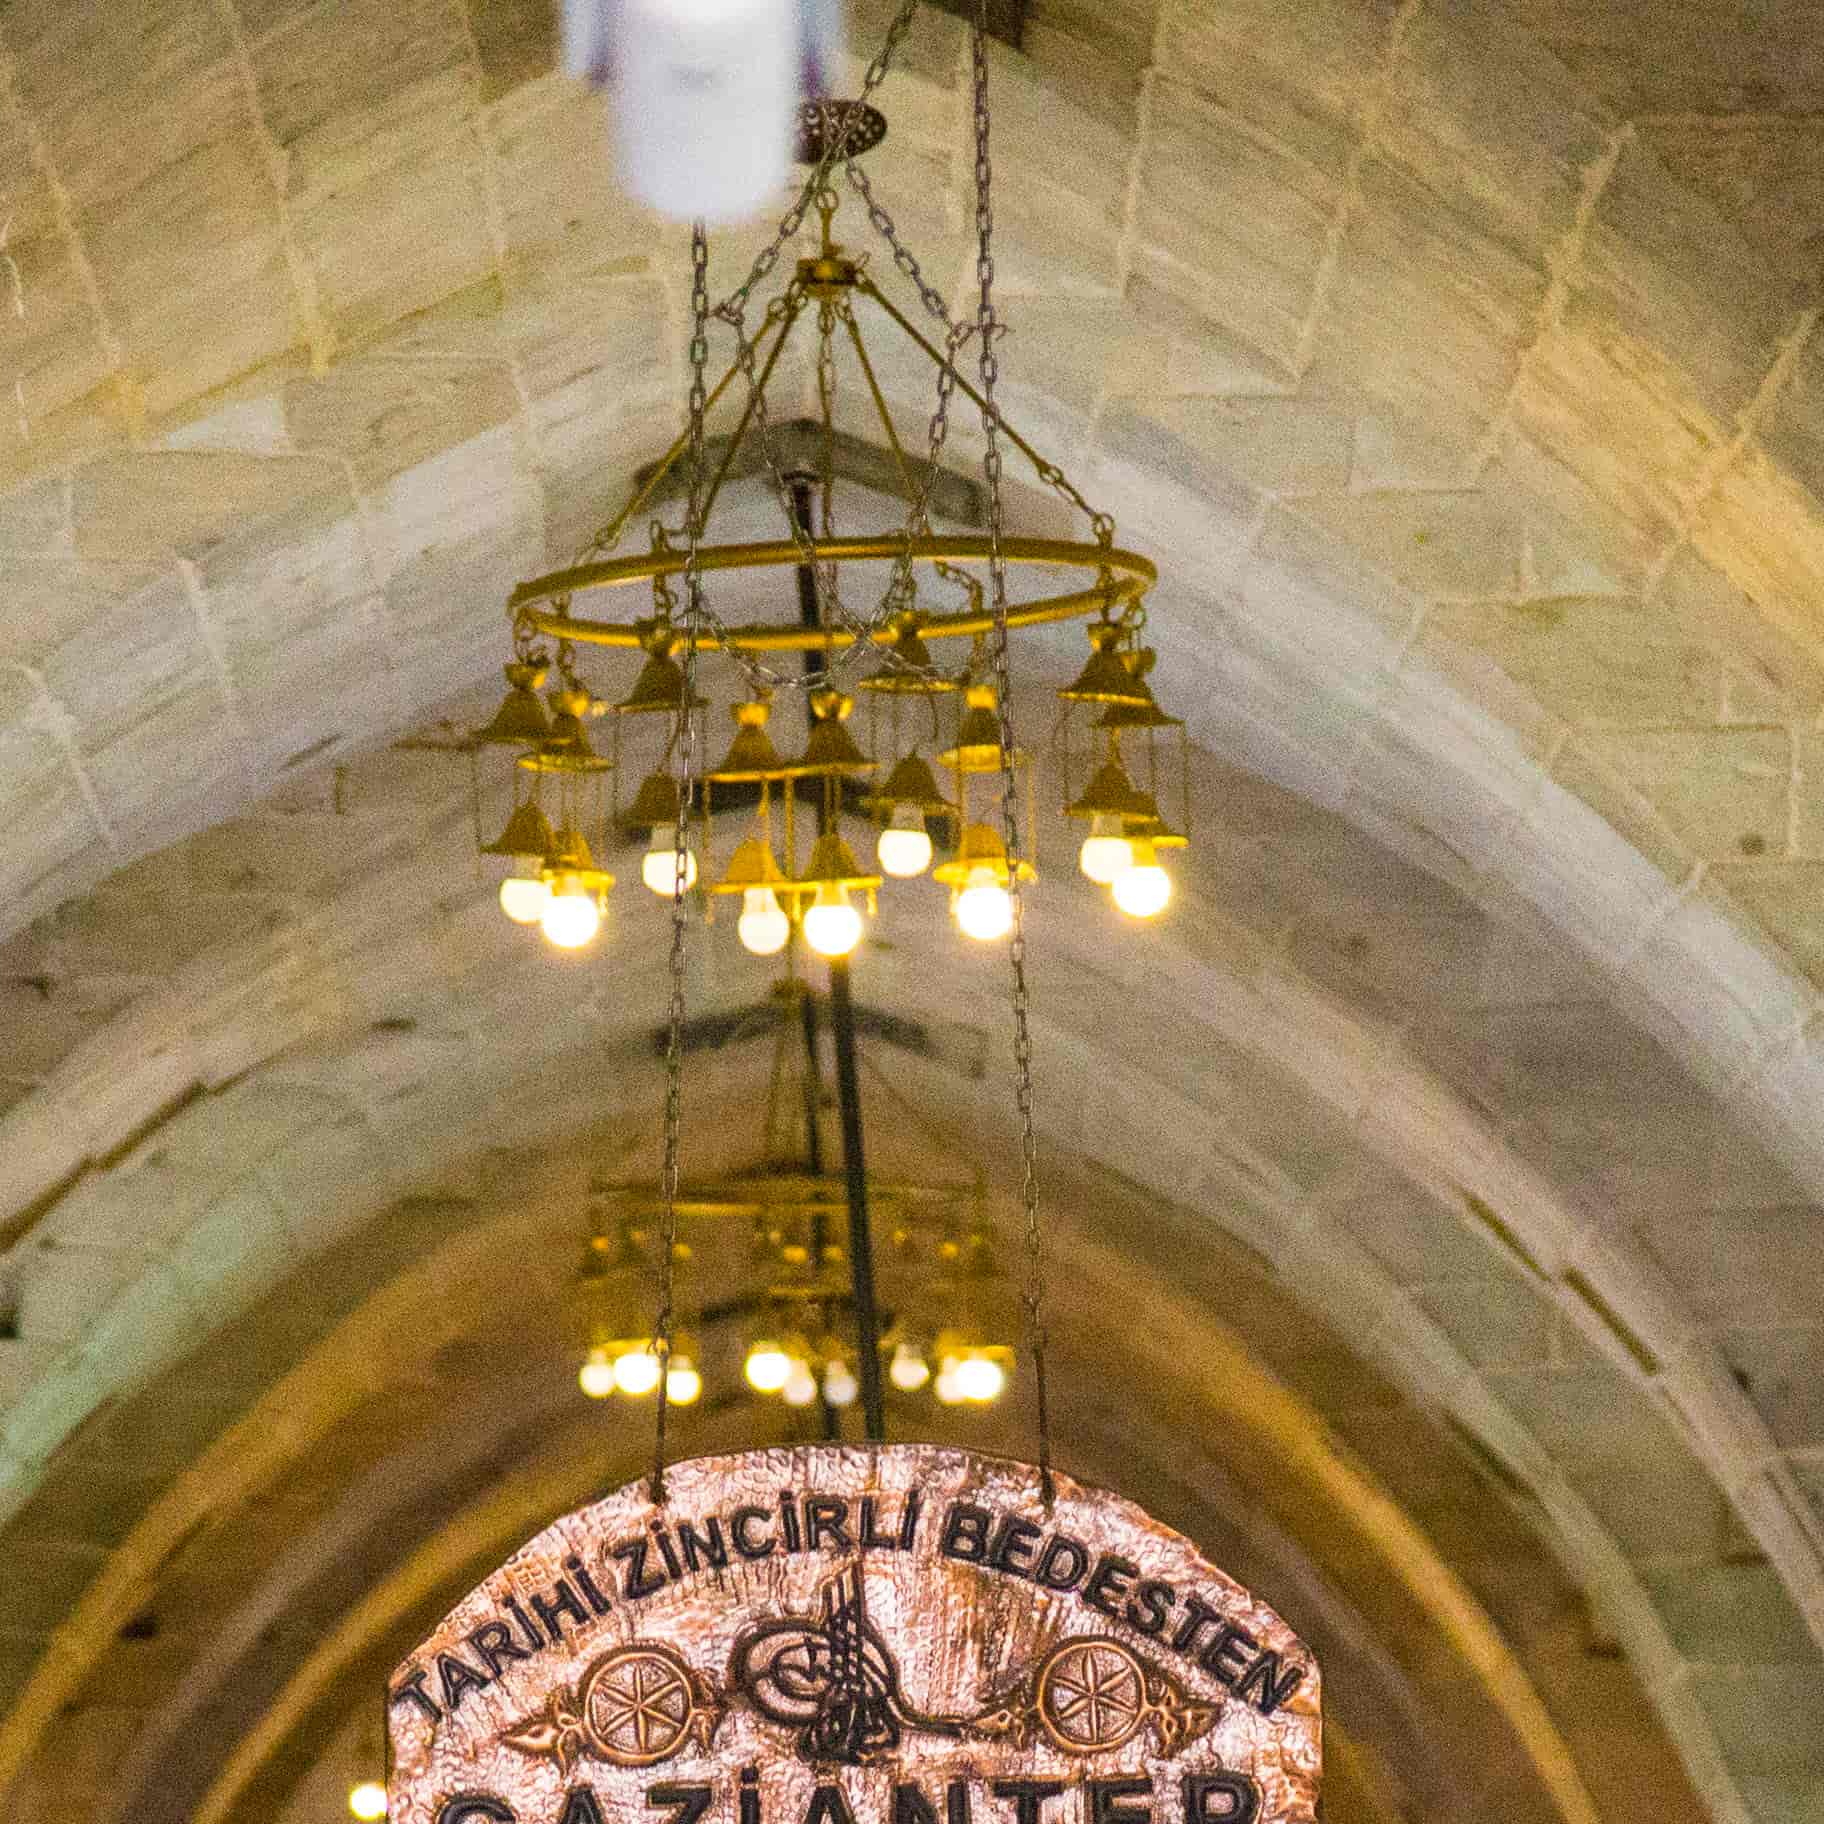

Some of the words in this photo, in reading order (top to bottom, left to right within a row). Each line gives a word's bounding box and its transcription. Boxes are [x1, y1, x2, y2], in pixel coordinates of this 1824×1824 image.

[393, 1554, 612, 1723] TARİHİ
[613, 1490, 920, 1600] ZİNCİRLİ
[942, 1501, 1304, 1716] BEDESTEN
